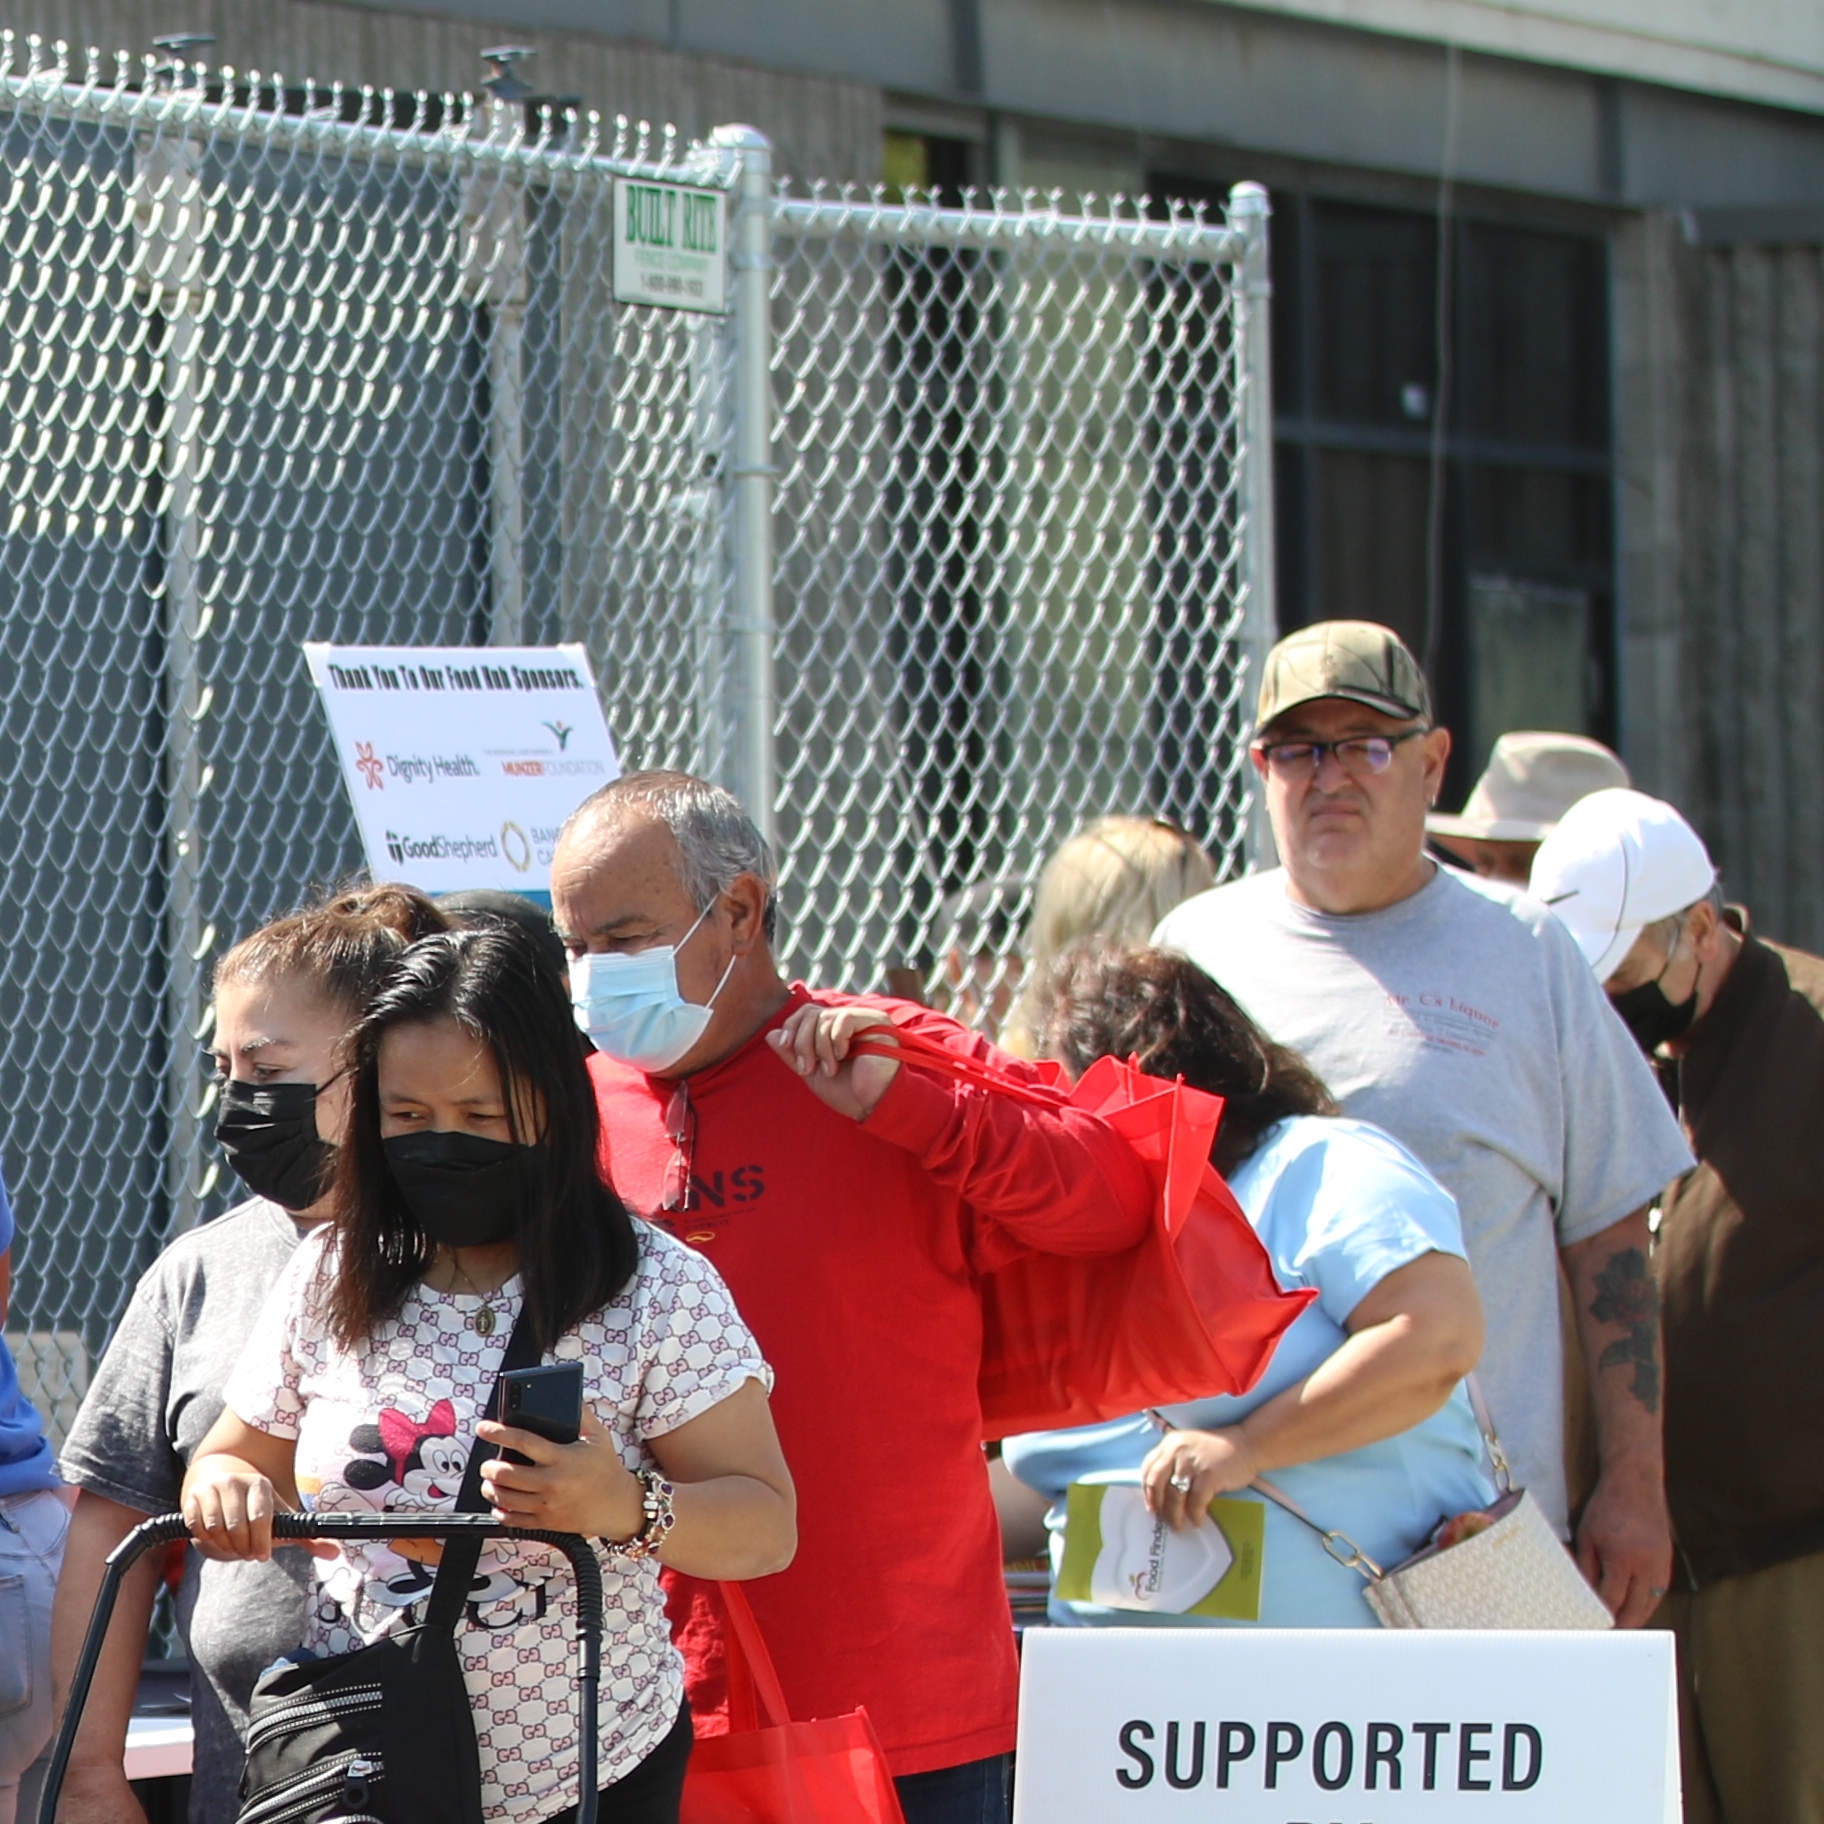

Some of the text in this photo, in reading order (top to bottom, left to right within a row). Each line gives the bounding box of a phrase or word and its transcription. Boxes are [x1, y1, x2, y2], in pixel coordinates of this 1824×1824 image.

[327, 664, 584, 692] Thank You To Our Food Hub Sponsors.
[386, 755, 434, 783] Dignity
[1115, 1719, 1543, 1792] SUPPORTED
